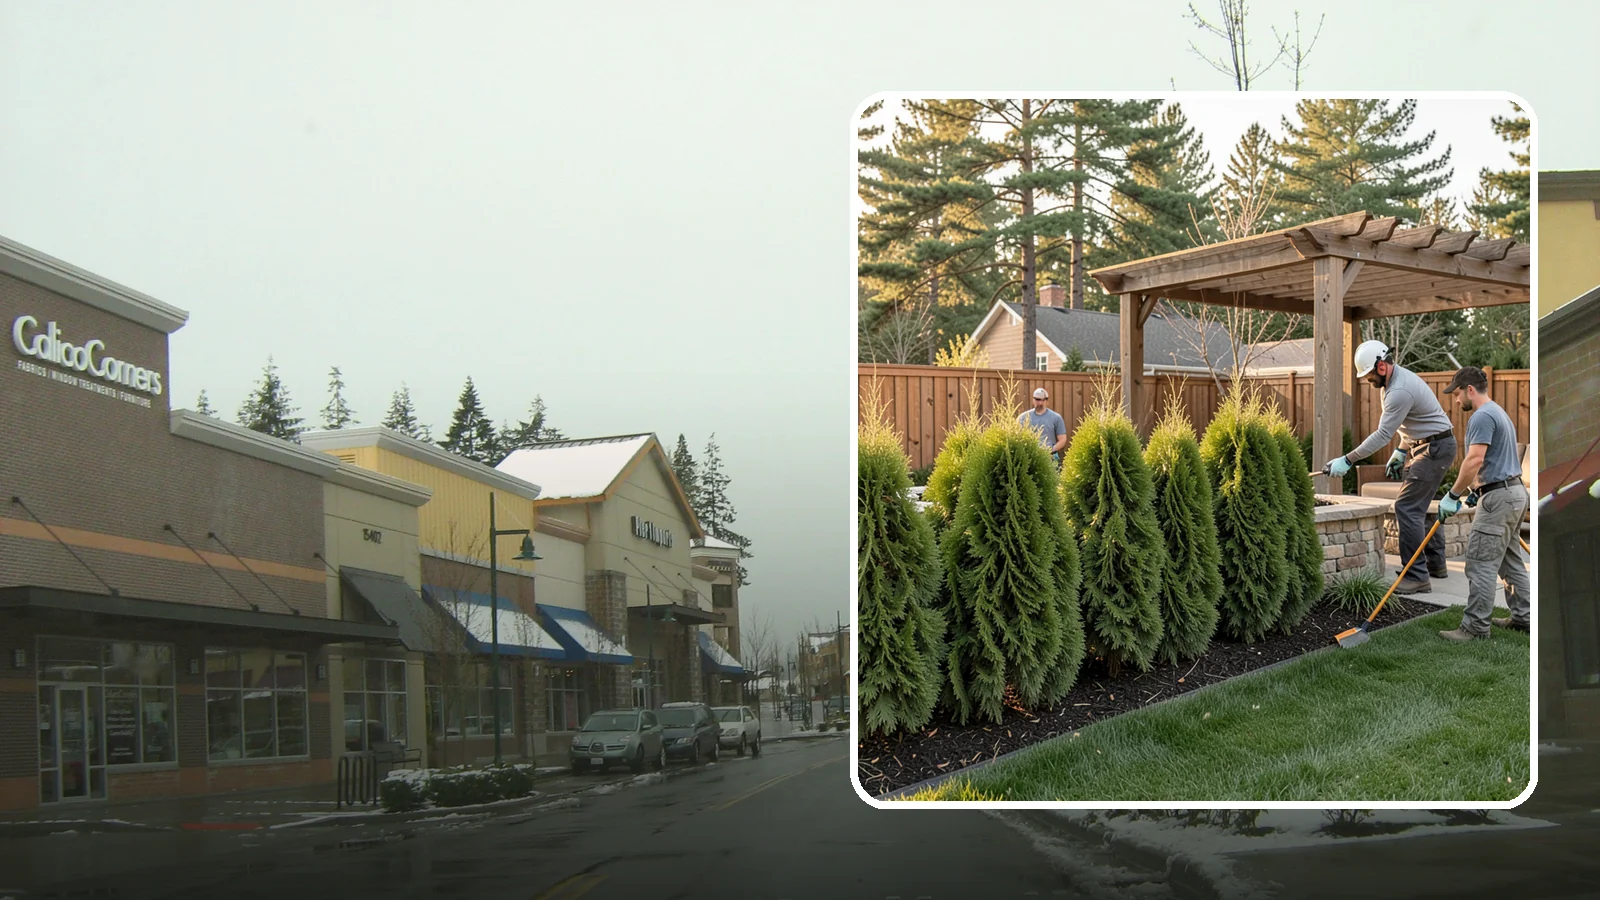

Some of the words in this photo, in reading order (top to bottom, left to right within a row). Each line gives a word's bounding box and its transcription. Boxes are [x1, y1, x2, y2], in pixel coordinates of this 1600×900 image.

[17, 360, 47, 377] FABRICS
[51, 370, 78, 386] WINDOW
[79, 378, 117, 398] TREATMENTS
[120, 391, 151, 408] FURNITURE
